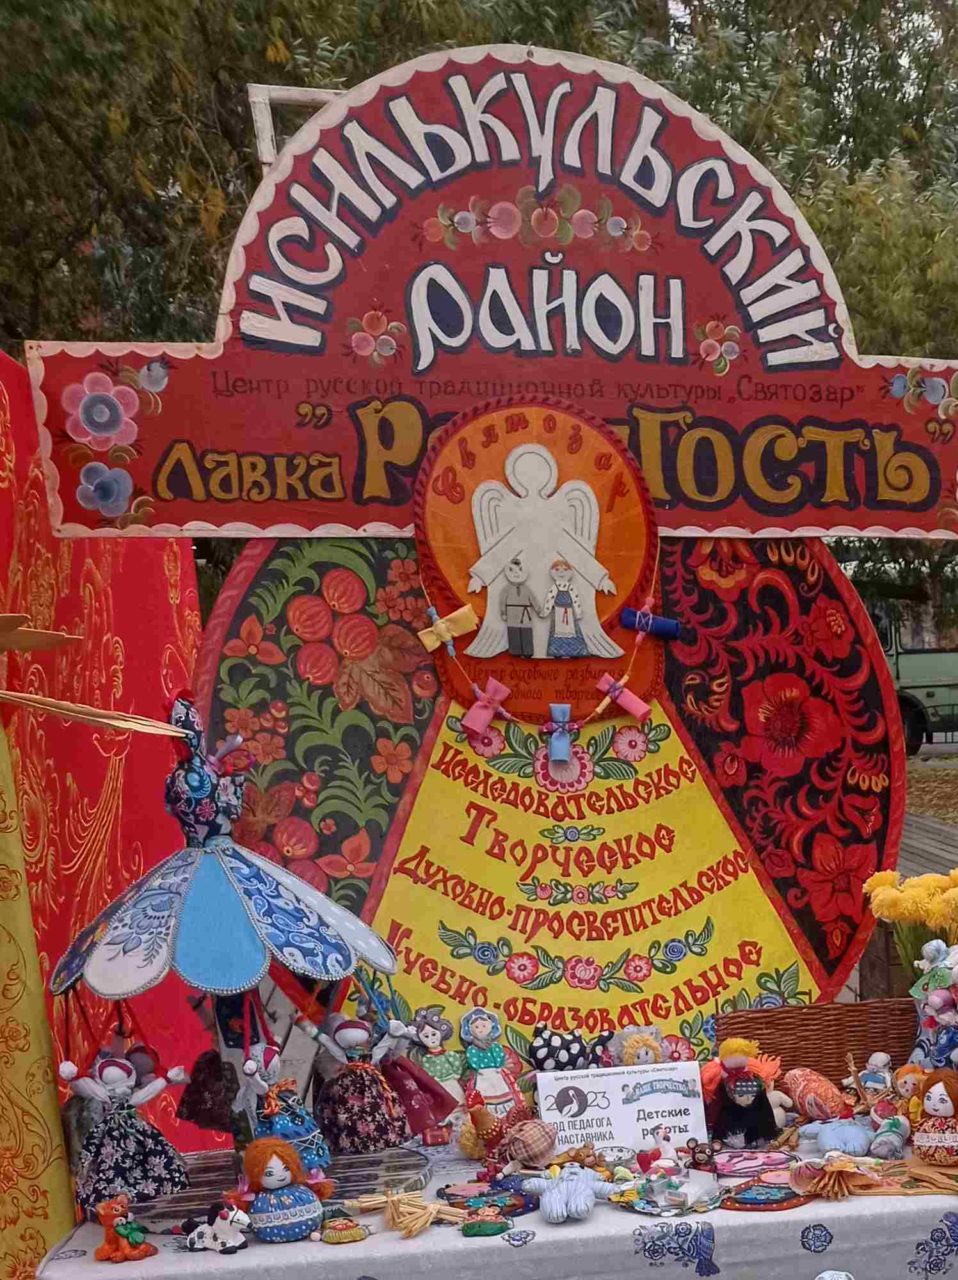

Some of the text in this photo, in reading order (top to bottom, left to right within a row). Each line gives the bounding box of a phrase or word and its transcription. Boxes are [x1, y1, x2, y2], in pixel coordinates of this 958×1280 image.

[239, 72, 843, 369] ИСИЛЬКУЛЬСКИЙ
[211, 370, 290, 399] Центр
[306, 376, 402, 399] русской
[415, 378, 605, 398] традиционной
[616, 382, 721, 404] культуры
[156, 441, 346, 501] Лавка
[458, 800, 676, 883] Творческое
[567, 1116, 613, 1131] ПЕДАГОГА
[636, 1108, 691, 1123] Детские
[557, 1130, 615, 1146] НАСТАВНИКА
